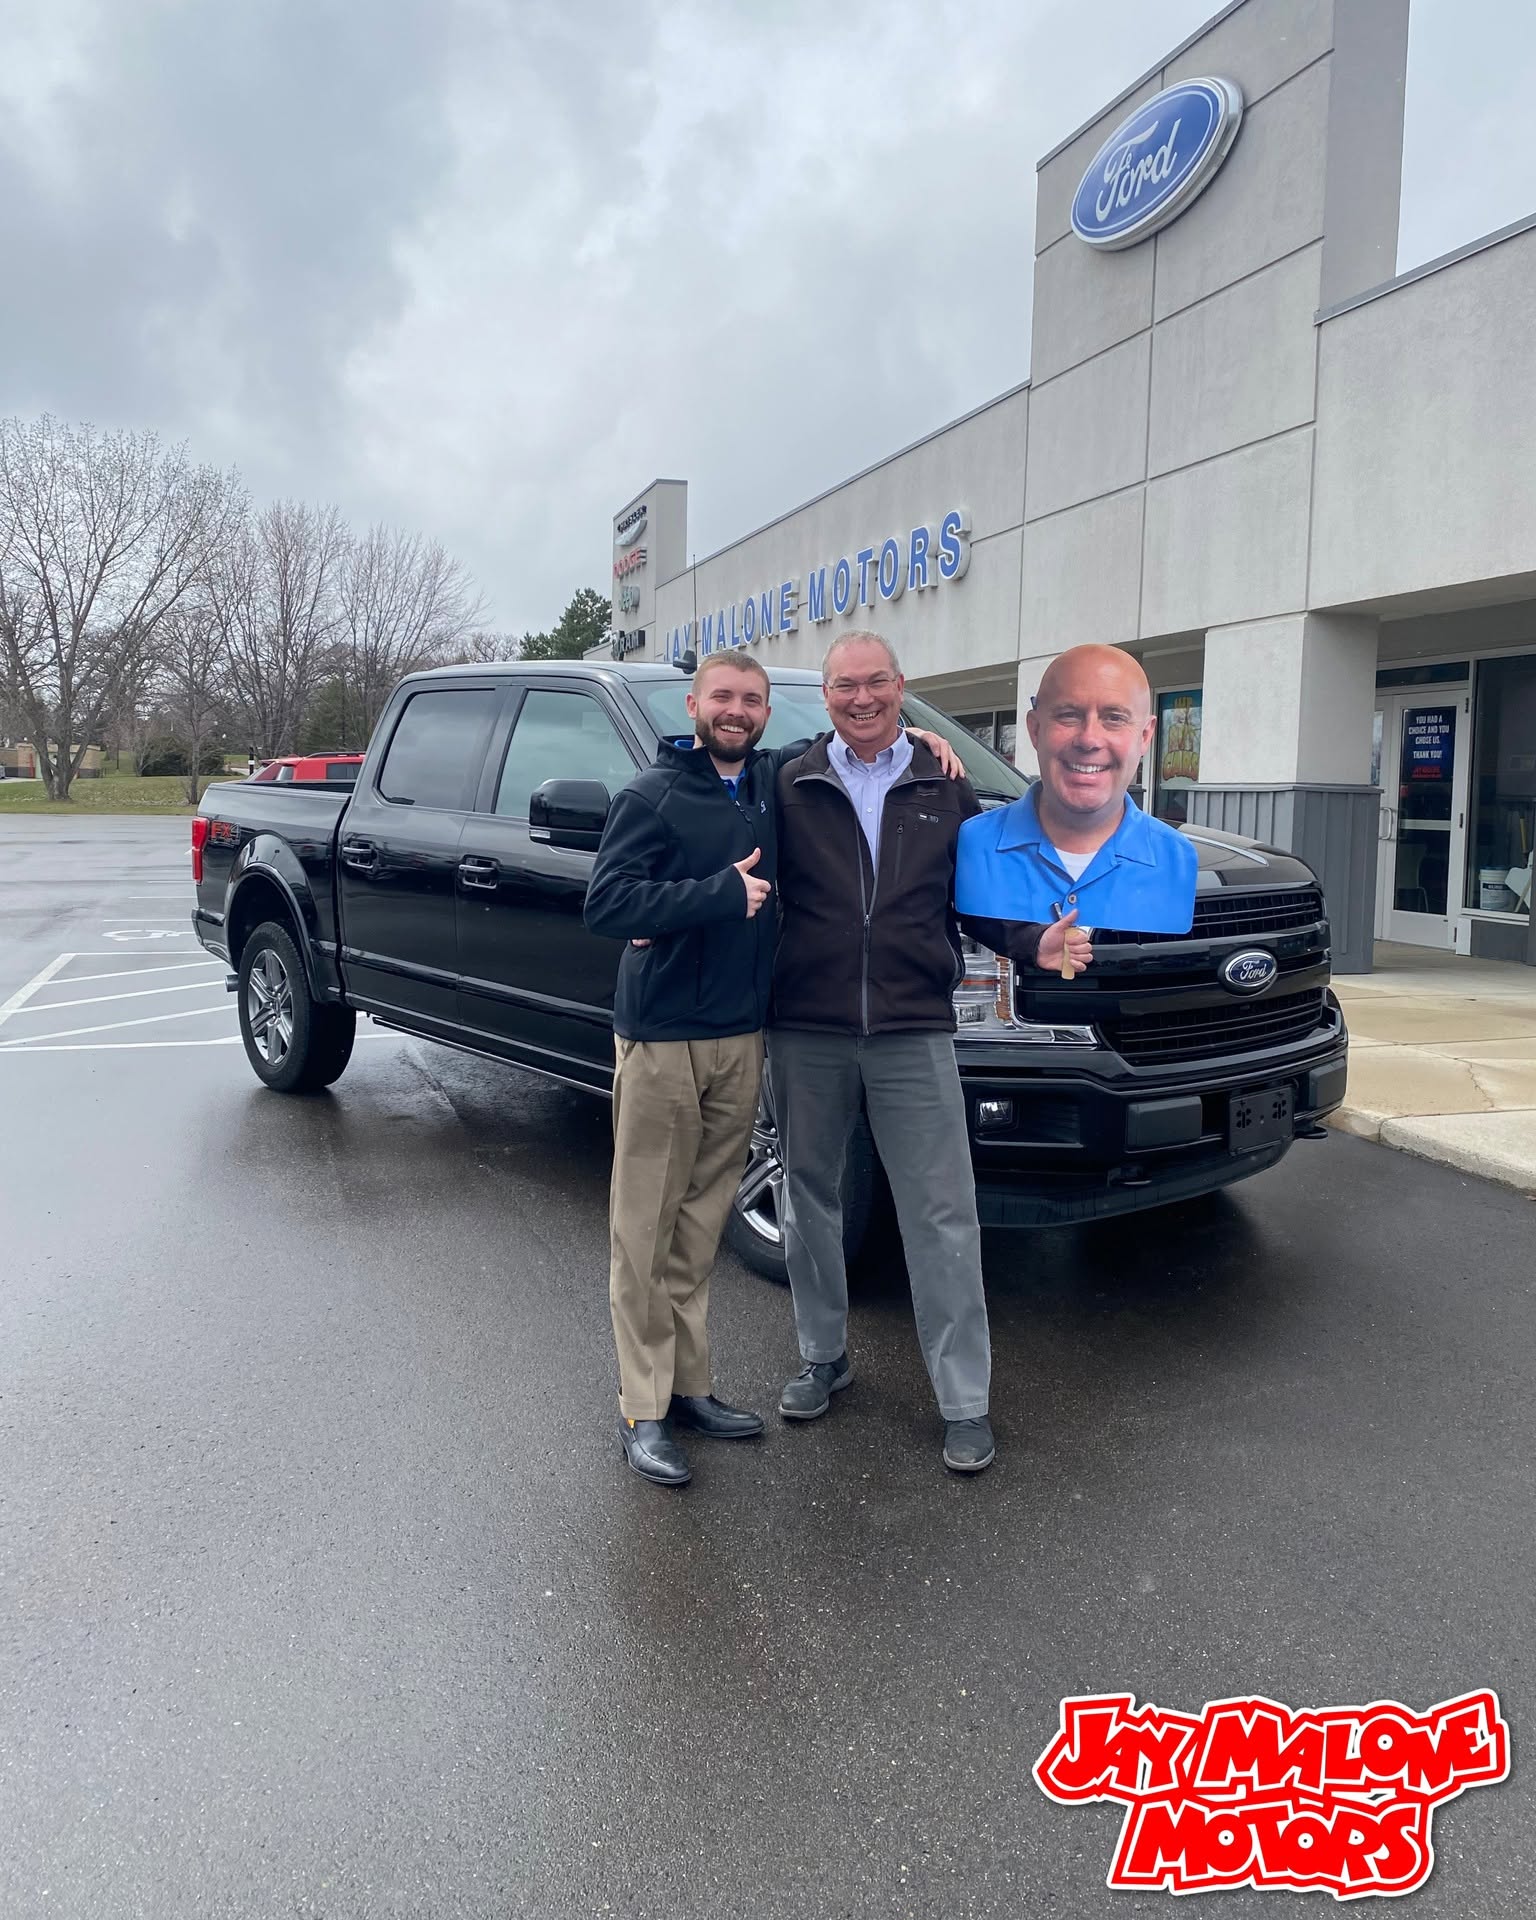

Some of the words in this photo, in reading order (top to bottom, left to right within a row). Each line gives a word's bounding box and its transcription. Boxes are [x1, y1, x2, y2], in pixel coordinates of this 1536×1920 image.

[1096, 118, 1182, 222] Ford
[664, 621, 693, 661] JAY
[702, 580, 796, 656] MALONE
[808, 509, 967, 624] MOTORS
[1416, 715, 1426, 724] YOU
[1427, 715, 1438, 724] HAD
[1408, 726, 1427, 735] CHOICE
[1427, 725, 1438, 734] AND
[1439, 725, 1450, 734] YOU
[1413, 750, 1429, 759] THANK
[211, 821, 240, 840] FX4
[1240, 960, 1267, 981] Ford
